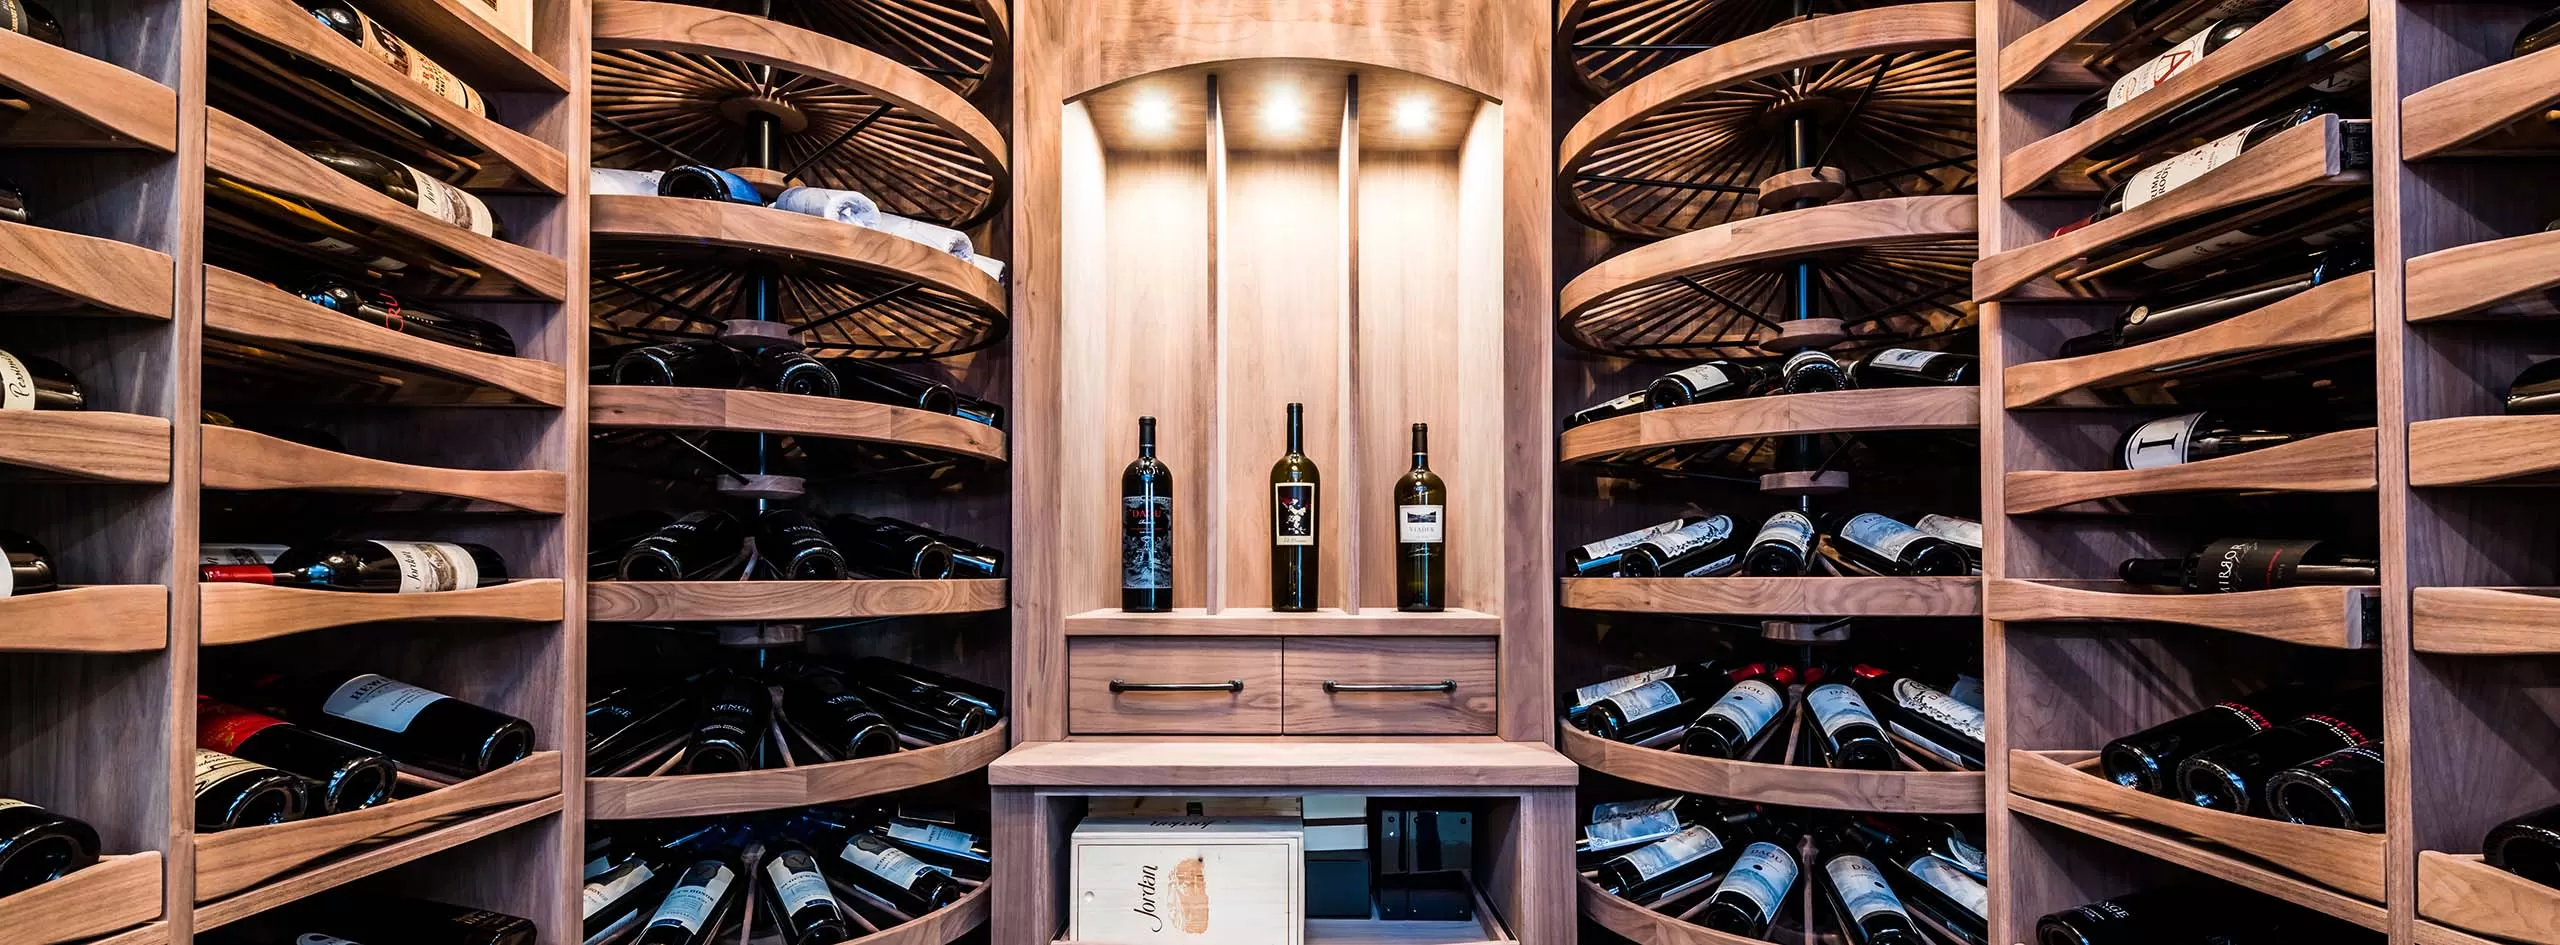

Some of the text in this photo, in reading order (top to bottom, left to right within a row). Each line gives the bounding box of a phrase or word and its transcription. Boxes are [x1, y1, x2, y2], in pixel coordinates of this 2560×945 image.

[2150, 169, 2165, 199] RIMAL
[379, 291, 404, 332] CRU
[1132, 508, 1161, 518] DAU
[1750, 848, 1783, 863] DAOU
[1133, 864, 1163, 933] Jordan
